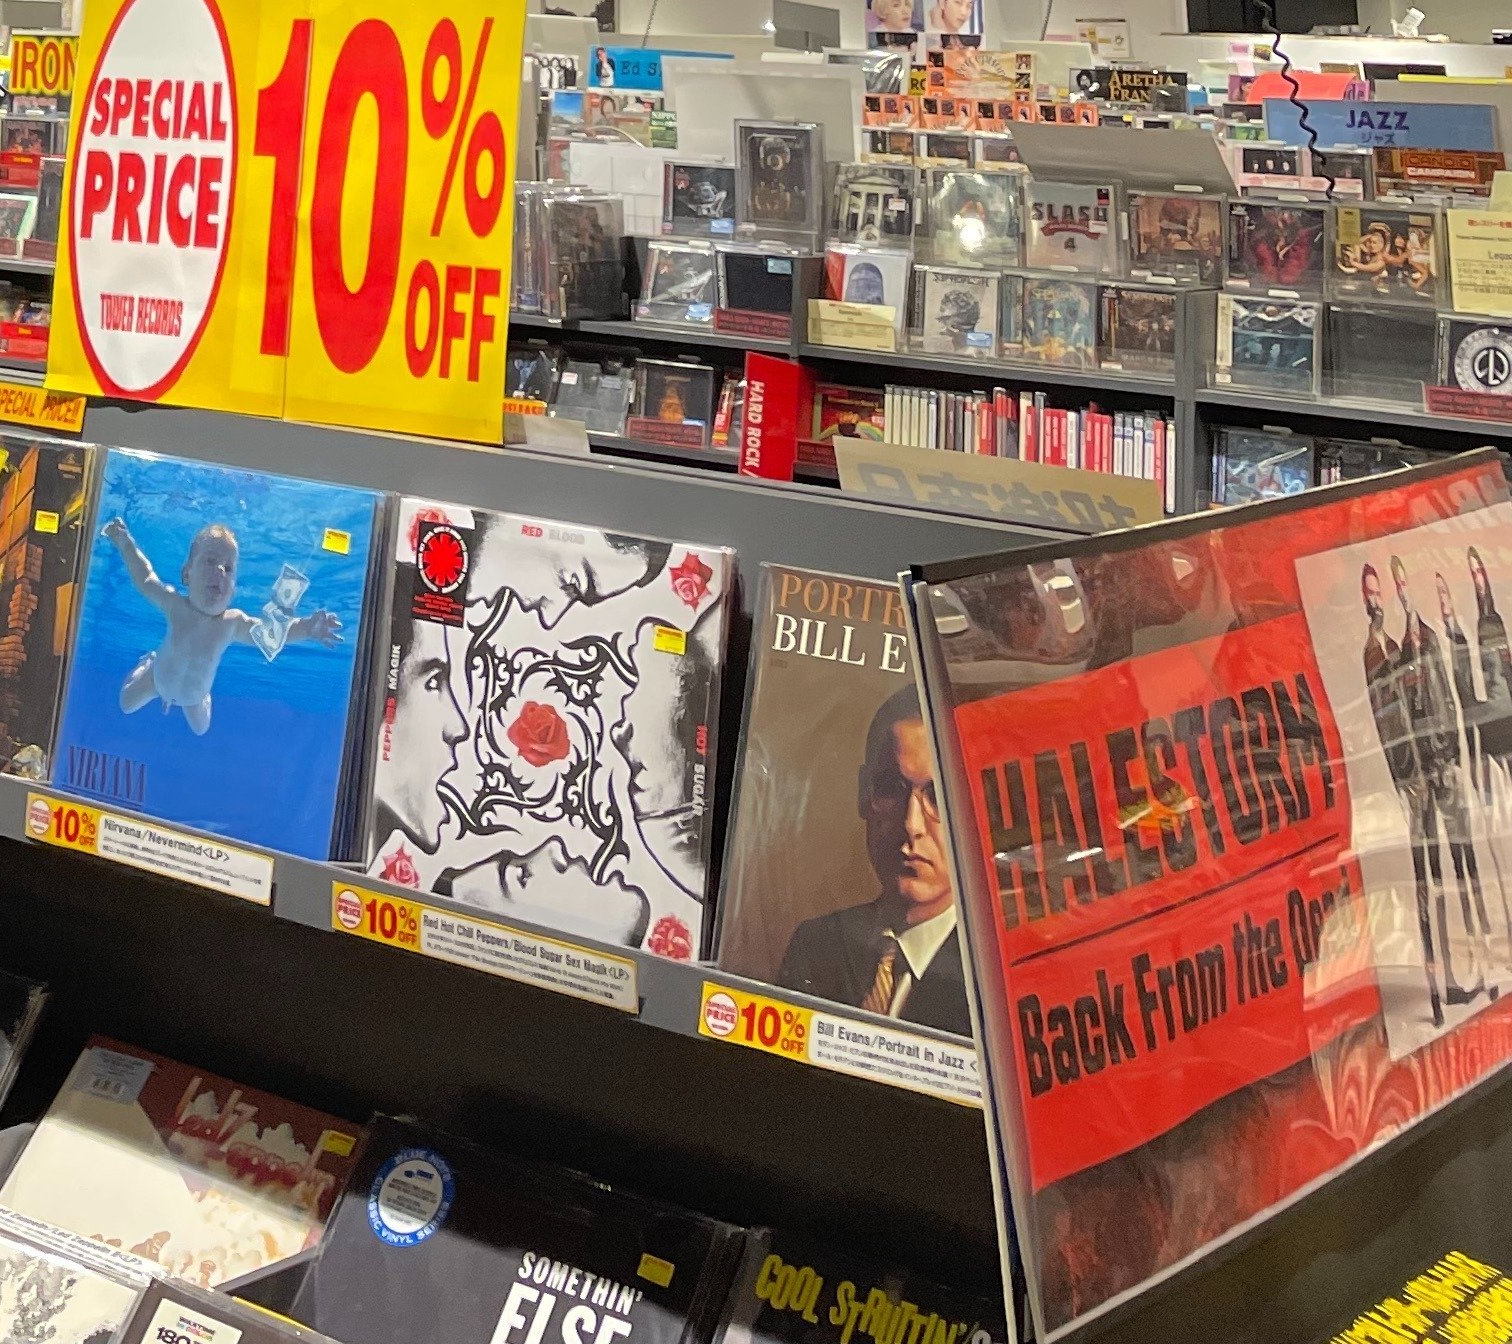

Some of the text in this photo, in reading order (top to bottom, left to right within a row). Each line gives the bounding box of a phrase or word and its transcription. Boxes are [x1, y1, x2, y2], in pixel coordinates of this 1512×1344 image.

[620, 64, 641, 77] Ed
[1108, 69, 1175, 89] ARETHA
[1108, 86, 1152, 102] FRAN
[89, 79, 229, 141] SPECIAL
[1345, 109, 1410, 131] JAZZ
[1360, 132, 1396, 146] ジャズ
[80, 150, 224, 250] PRICE
[254, 16, 505, 375] 10%
[1063, 237, 1077, 253] 4
[99, 291, 183, 339] TOWER RECORDS
[405, 258, 503, 384] OFF
[742, 379, 765, 469] HARD ROCK
[520, 524, 544, 538] RED
[779, 572, 906, 630] PORTR
[772, 614, 866, 665] BILL
[387, 644, 402, 691] MAGIK
[697, 724, 709, 757] HOT
[981, 671, 1336, 932] HALESTORM
[364, 897, 417, 939] 10%
[1016, 968, 1137, 1099] Back
[1131, 952, 1227, 1052] From
[1232, 913, 1287, 1005] the
[740, 1000, 805, 1047] 10%
[779, 1036, 805, 1055] OFF
[816, 1020, 835, 1038] Bill
[923, 1048, 936, 1061] in
[937, 1052, 965, 1070] Jazz
[517, 1251, 644, 1316] SOMETHIN'
[755, 1253, 825, 1324] COOL
